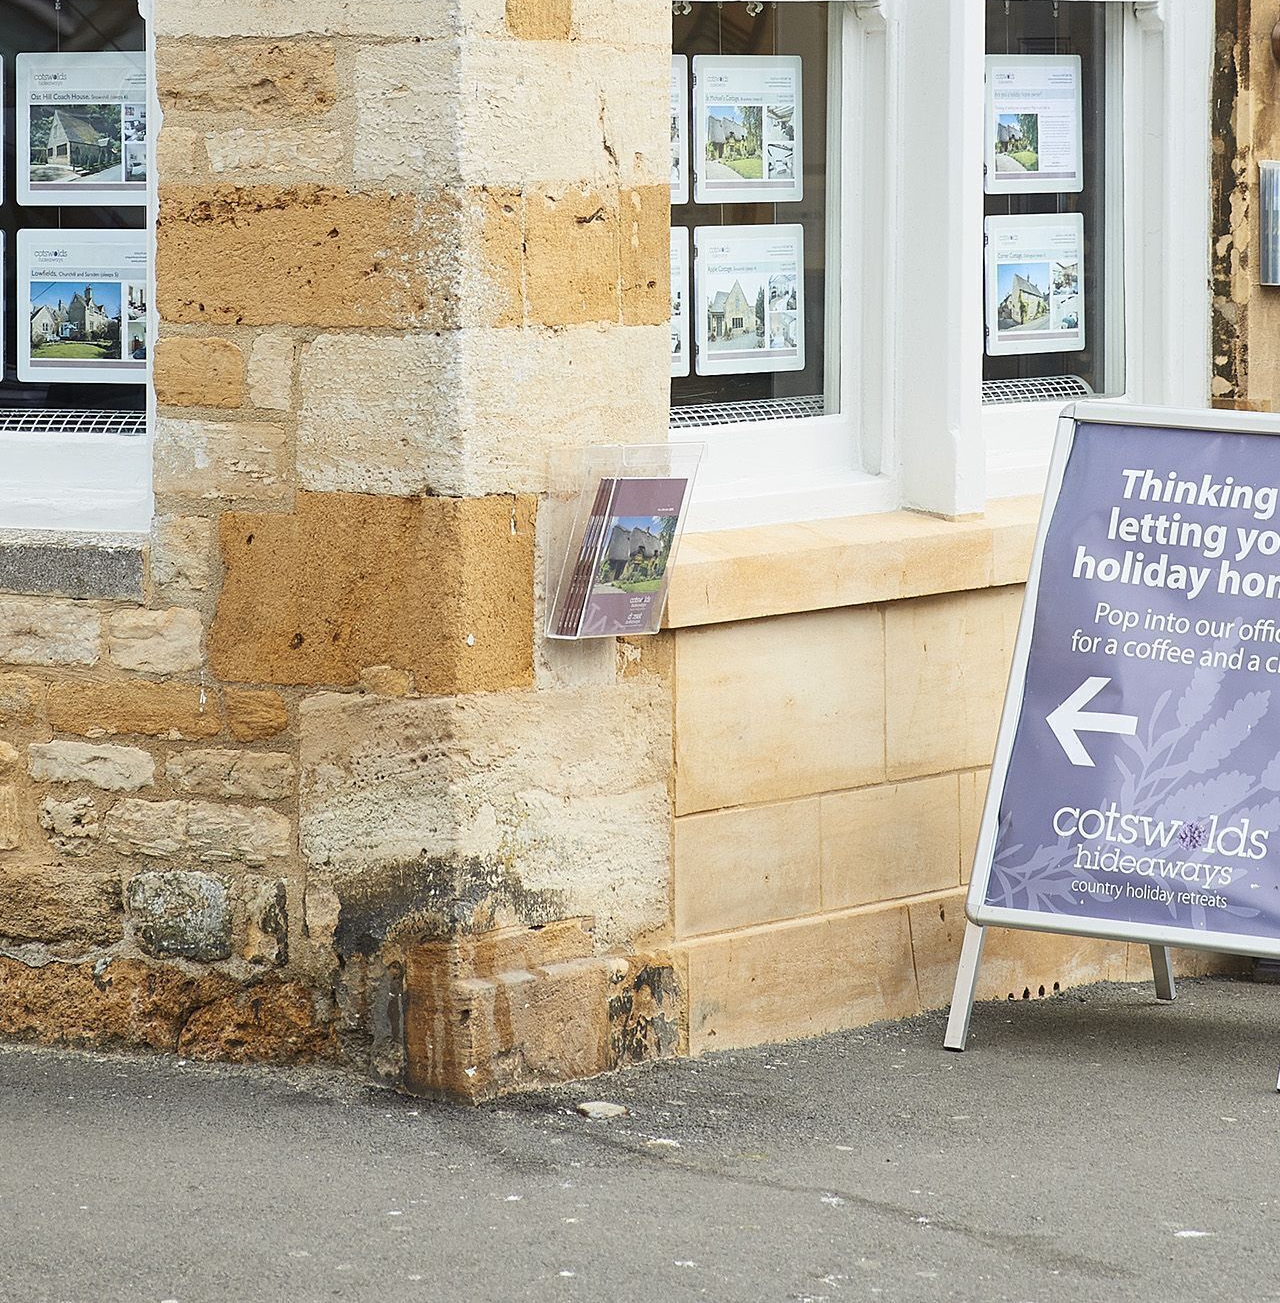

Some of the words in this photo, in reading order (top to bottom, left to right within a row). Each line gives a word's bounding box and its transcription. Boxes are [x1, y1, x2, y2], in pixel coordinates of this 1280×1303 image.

[1121, 468, 1276, 520] Thinking
[1107, 507, 1227, 559] letting
[1072, 546, 1213, 600] holiday
[1093, 602, 1139, 632] Pop
[1144, 608, 1190, 635] into
[1195, 618, 1234, 638] our
[1071, 629, 1101, 655] for
[1105, 640, 1119, 657] a
[1123, 636, 1195, 667] coffee
[1200, 645, 1243, 671] and
[1248, 656, 1262, 673] a
[1073, 844, 1233, 890] hideaways
[1071, 878, 1123, 901] country
[1126, 880, 1175, 908] holiday
[1177, 888, 1228, 909] retreats
